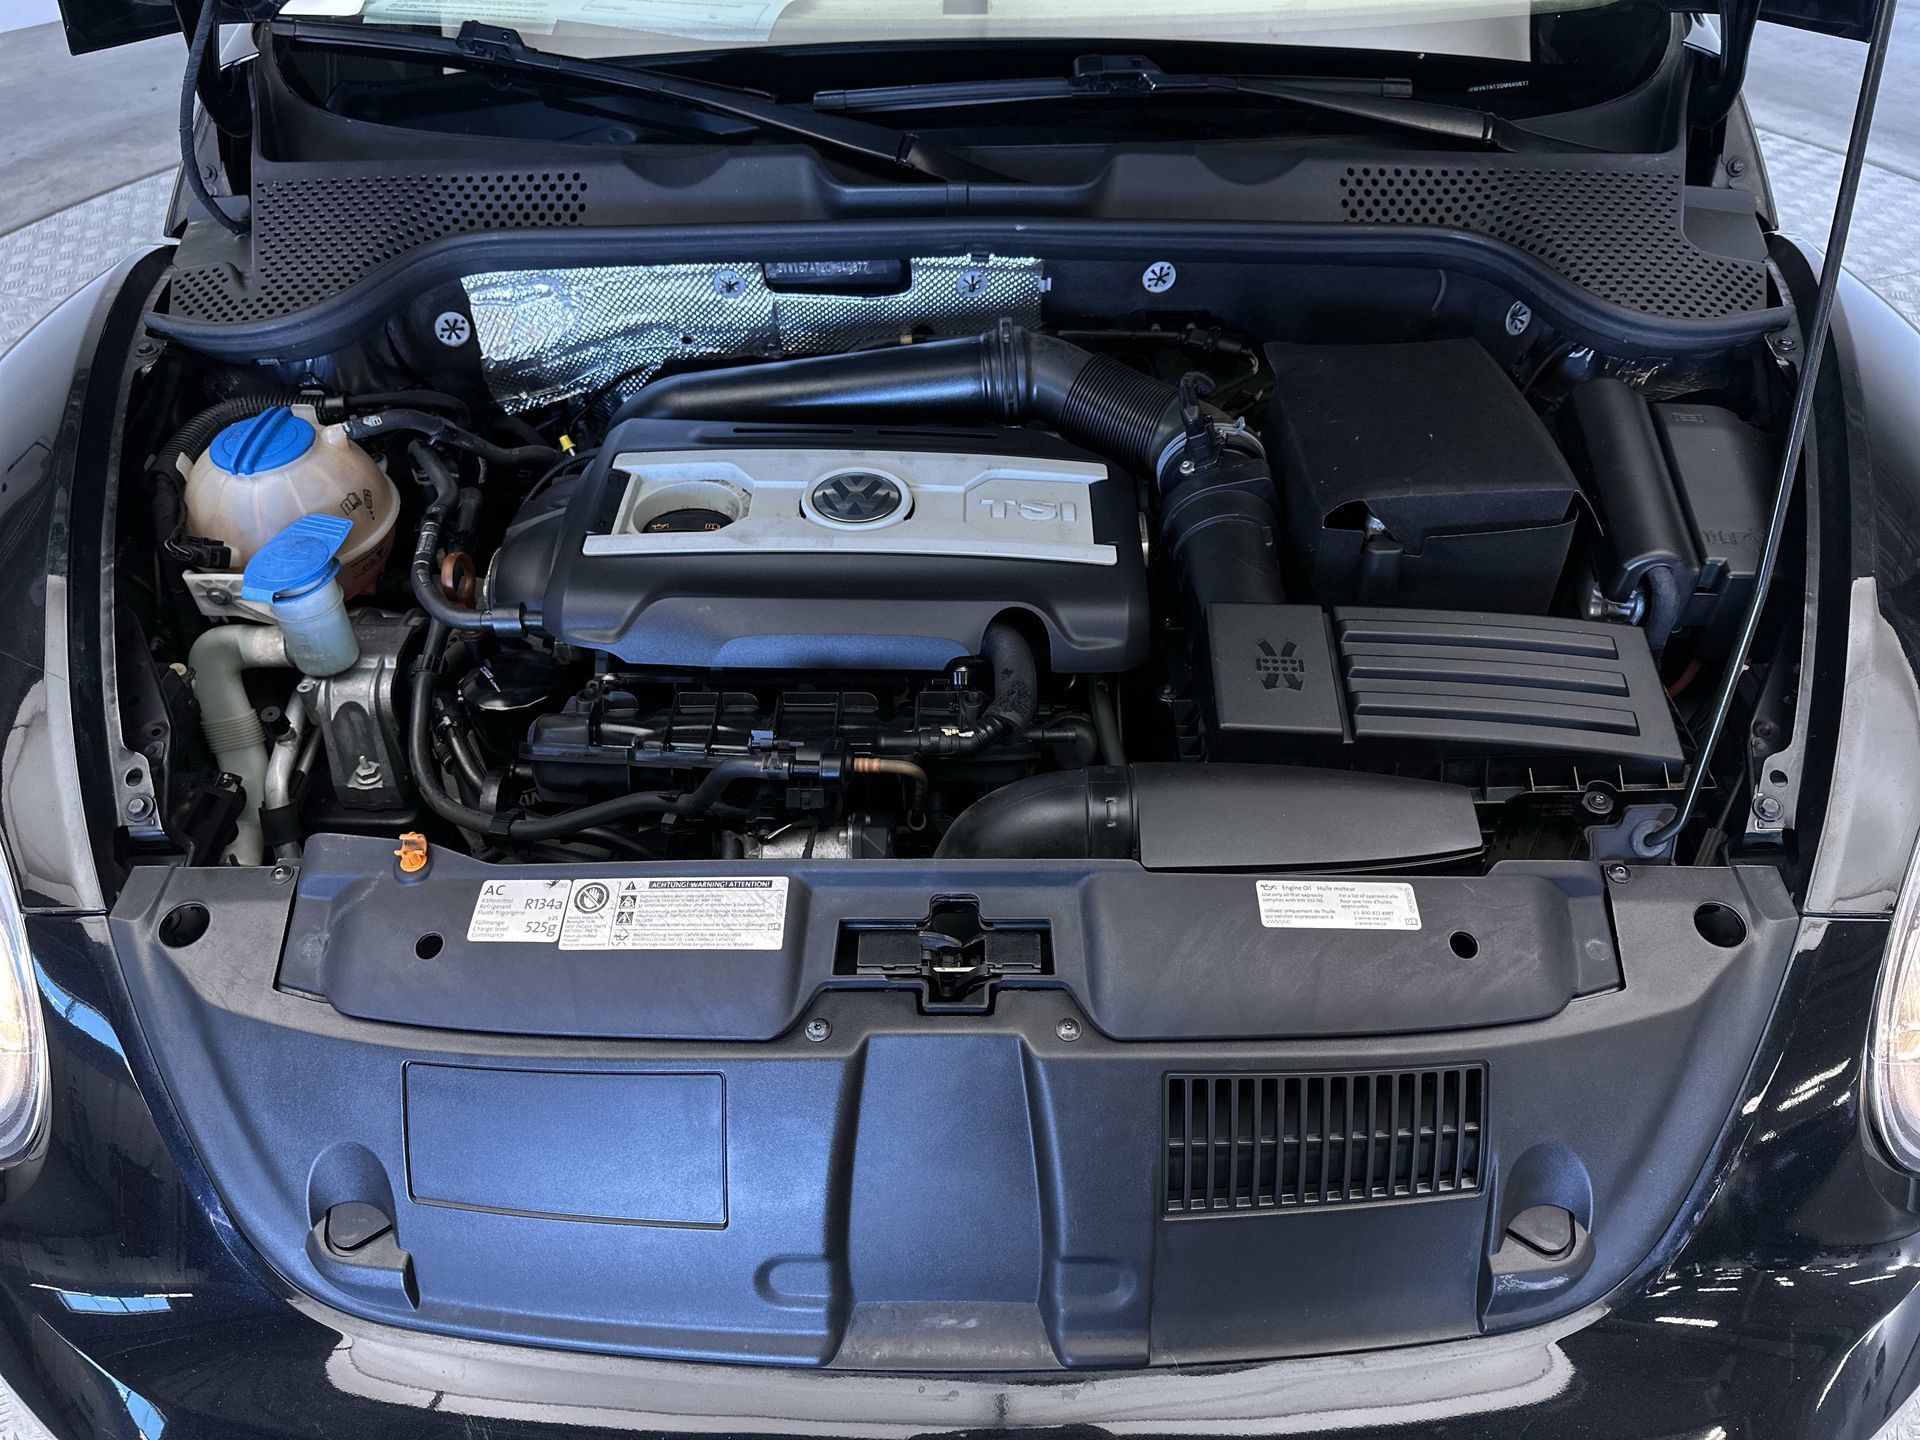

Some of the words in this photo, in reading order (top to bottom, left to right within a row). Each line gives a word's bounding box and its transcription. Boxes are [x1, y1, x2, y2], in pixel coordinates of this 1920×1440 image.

[979, 499, 1076, 523] TSI
[484, 885, 506, 896] AC
[524, 898, 563, 910] R134a
[524, 921, 557, 937] 525g
